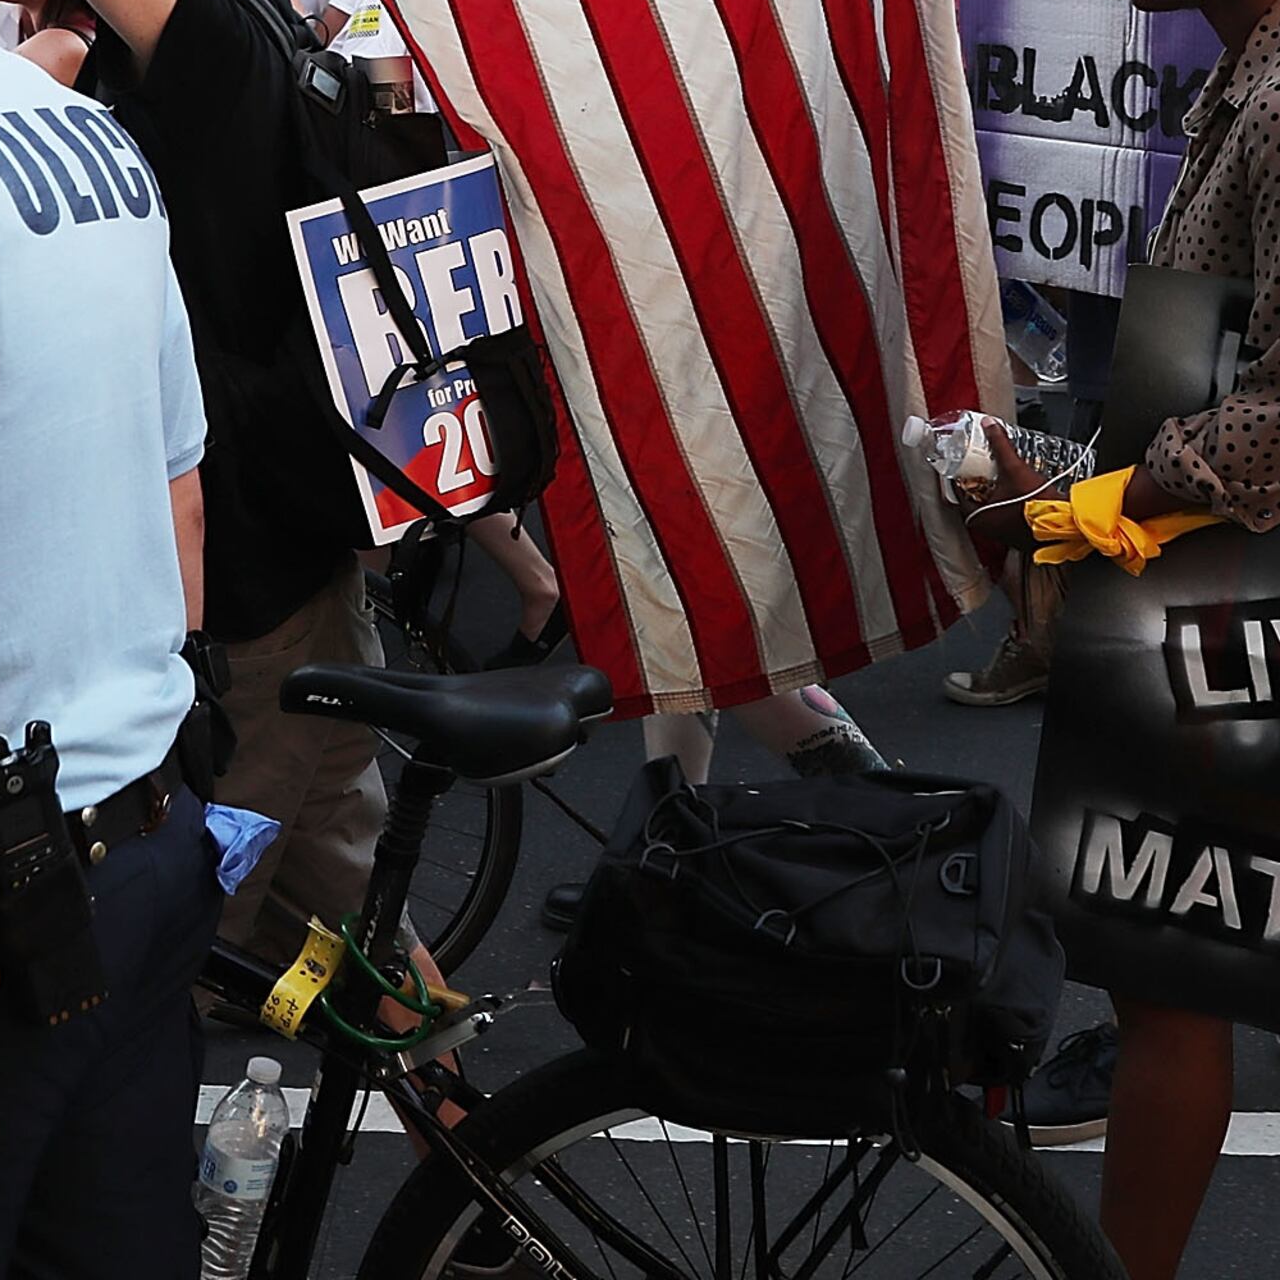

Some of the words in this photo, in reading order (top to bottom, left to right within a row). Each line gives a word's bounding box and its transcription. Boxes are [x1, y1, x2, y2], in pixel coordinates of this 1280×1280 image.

[976, 43, 1210, 138] BLACK
[331, 230, 361, 267] W
[379, 208, 453, 252] Want
[427, 386, 456, 408] for
